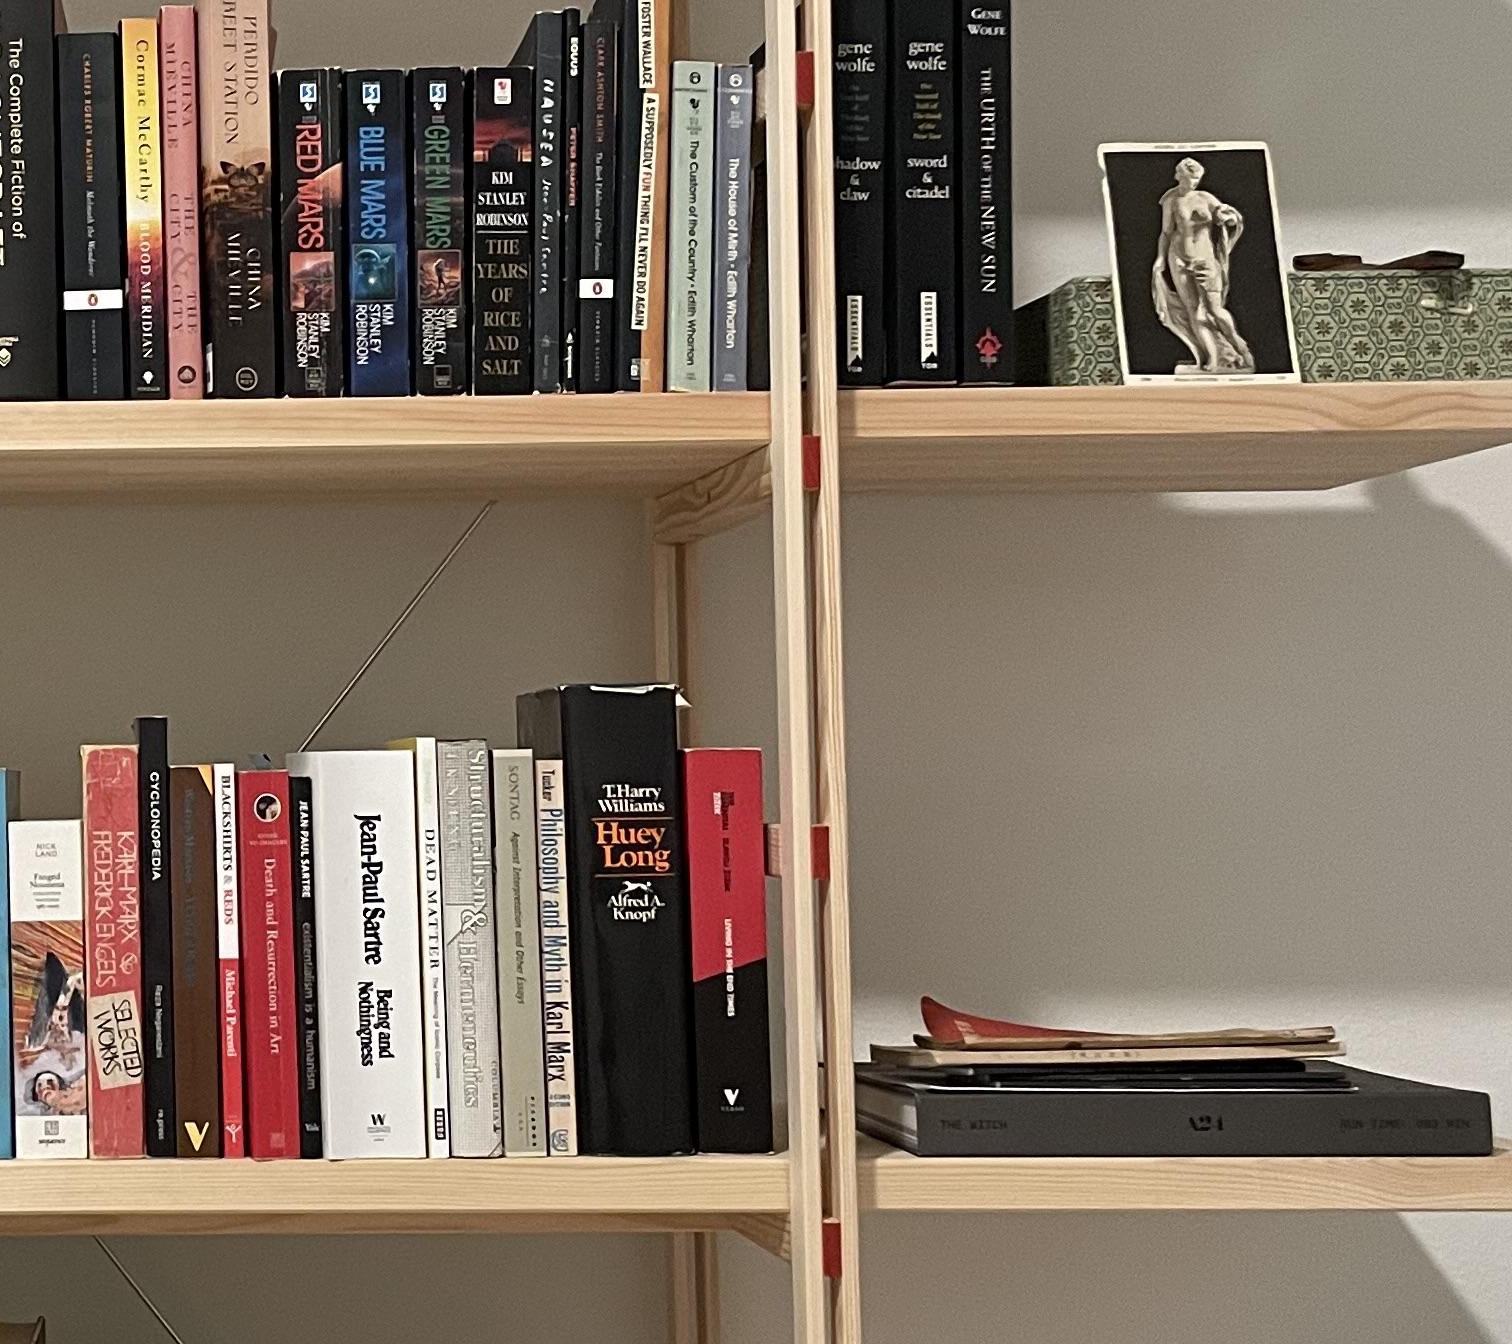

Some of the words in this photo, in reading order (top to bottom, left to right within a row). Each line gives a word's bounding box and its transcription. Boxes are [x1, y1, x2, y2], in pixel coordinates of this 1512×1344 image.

[640, 1, 651, 37] FOSTER
[9, 39, 23, 68] The
[641, 40, 653, 85] WALLACE
[135, 39, 152, 107] Cormac
[981, 68, 992, 95] THE
[8, 73, 24, 154] Complete
[981, 98, 994, 151] URTH
[295, 123, 322, 172] RED
[642, 107, 655, 170] SUPPOSEDLY
[135, 116, 153, 202] McCarthy
[981, 155, 992, 173] OF
[11, 159, 26, 217] Fiction
[641, 171, 653, 192] FUN
[981, 177, 992, 202] THE
[297, 179, 324, 249] MARS
[639, 195, 651, 224] THING
[981, 206, 994, 249] NEW
[12, 221, 26, 239] of
[139, 223, 152, 275] BLOOD
[639, 227, 650, 242] I'LL
[637, 245, 649, 278] NEVER
[981, 255, 996, 293] SUN
[636, 280, 648, 294] DO
[140, 281, 153, 359] MERIDIAN
[318, 313, 330, 333] KIM
[634, 296, 646, 326] AGAIN
[296, 312, 309, 368] ROBINSON
[307, 312, 319, 357] STANLEY
[542, 770, 556, 801] Tucker
[598, 799, 665, 812] Williams
[149, 772, 161, 880] CYCLONOPEDIA
[595, 822, 665, 849] Huey
[354, 814, 384, 903] Jean-Paul
[538, 808, 564, 893] Philosophy
[602, 845, 671, 872] Long
[543, 900, 564, 929] and
[613, 906, 656, 922] Knopf
[364, 907, 385, 964] Sartre
[540, 936, 566, 974] Myth
[546, 979, 566, 994] in
[357, 981, 375, 1066] Nothingness
[374, 989, 392, 1029] Being
[546, 1001, 569, 1036] Karl
[378, 1031, 394, 1058] and
[547, 1042, 570, 1082] Marx
